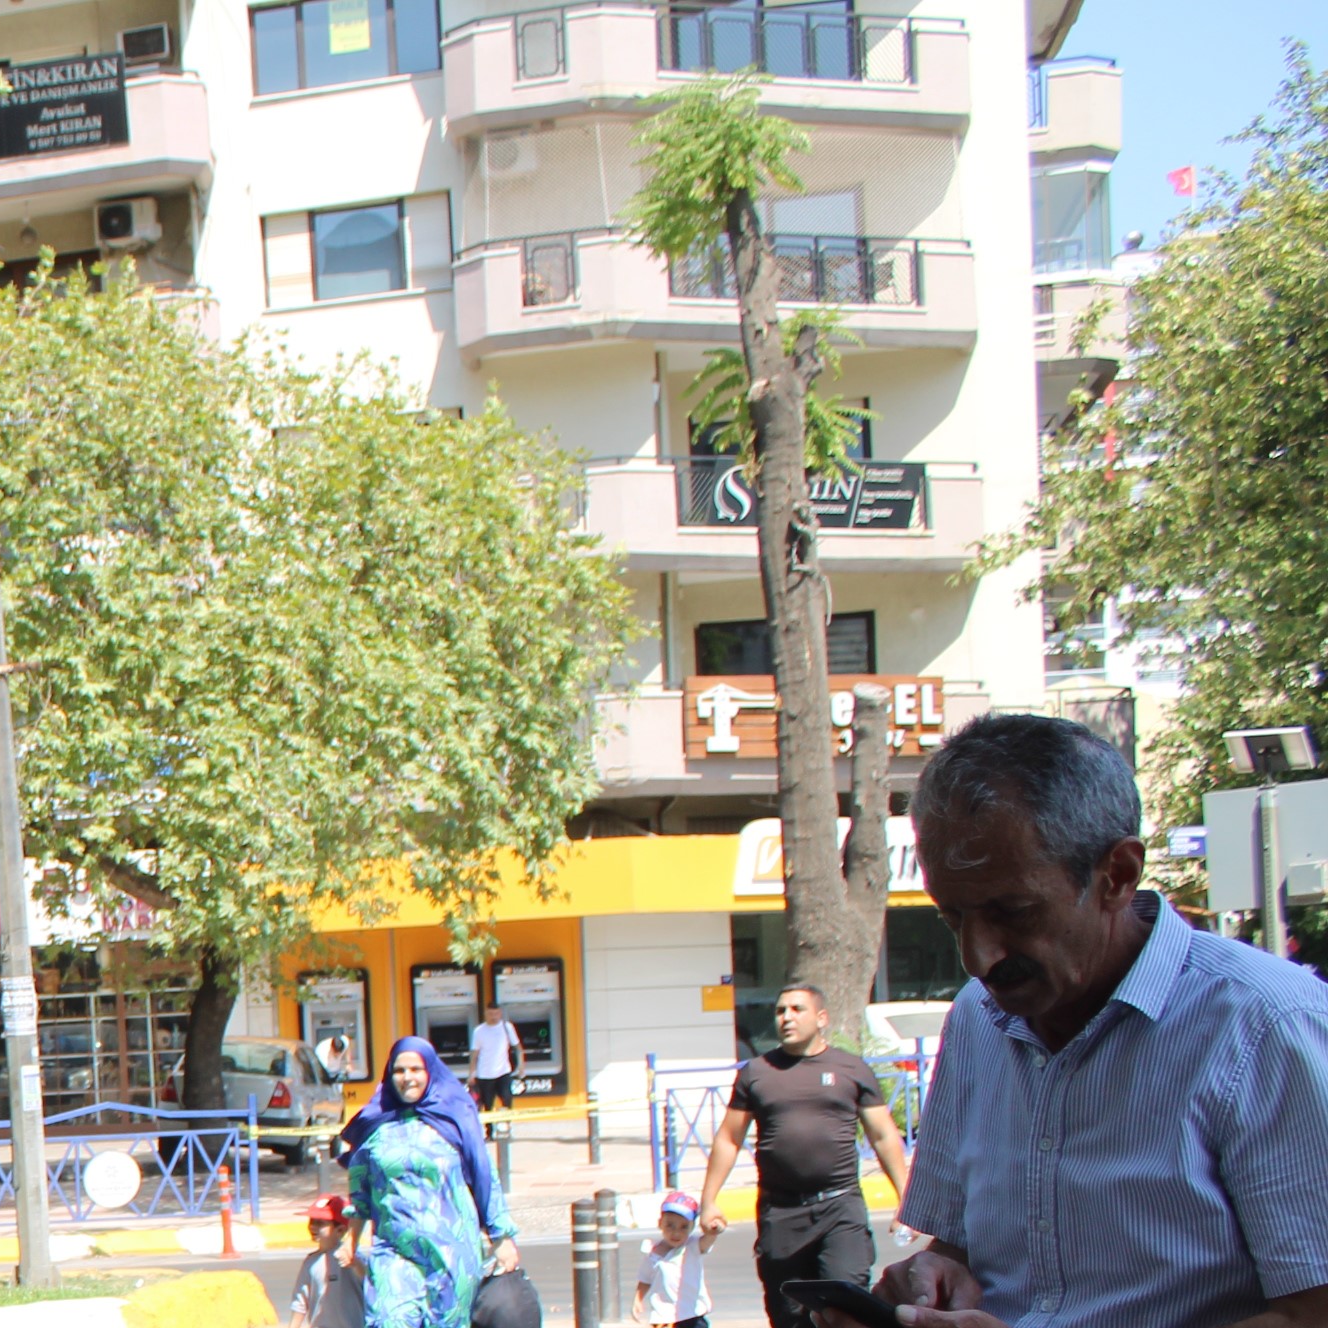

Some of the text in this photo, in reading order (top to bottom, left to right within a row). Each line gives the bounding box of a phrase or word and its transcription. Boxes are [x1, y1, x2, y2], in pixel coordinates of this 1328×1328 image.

[39, 102, 86, 121] Avukat
[25, 115, 102, 139] Mert KIRAN
